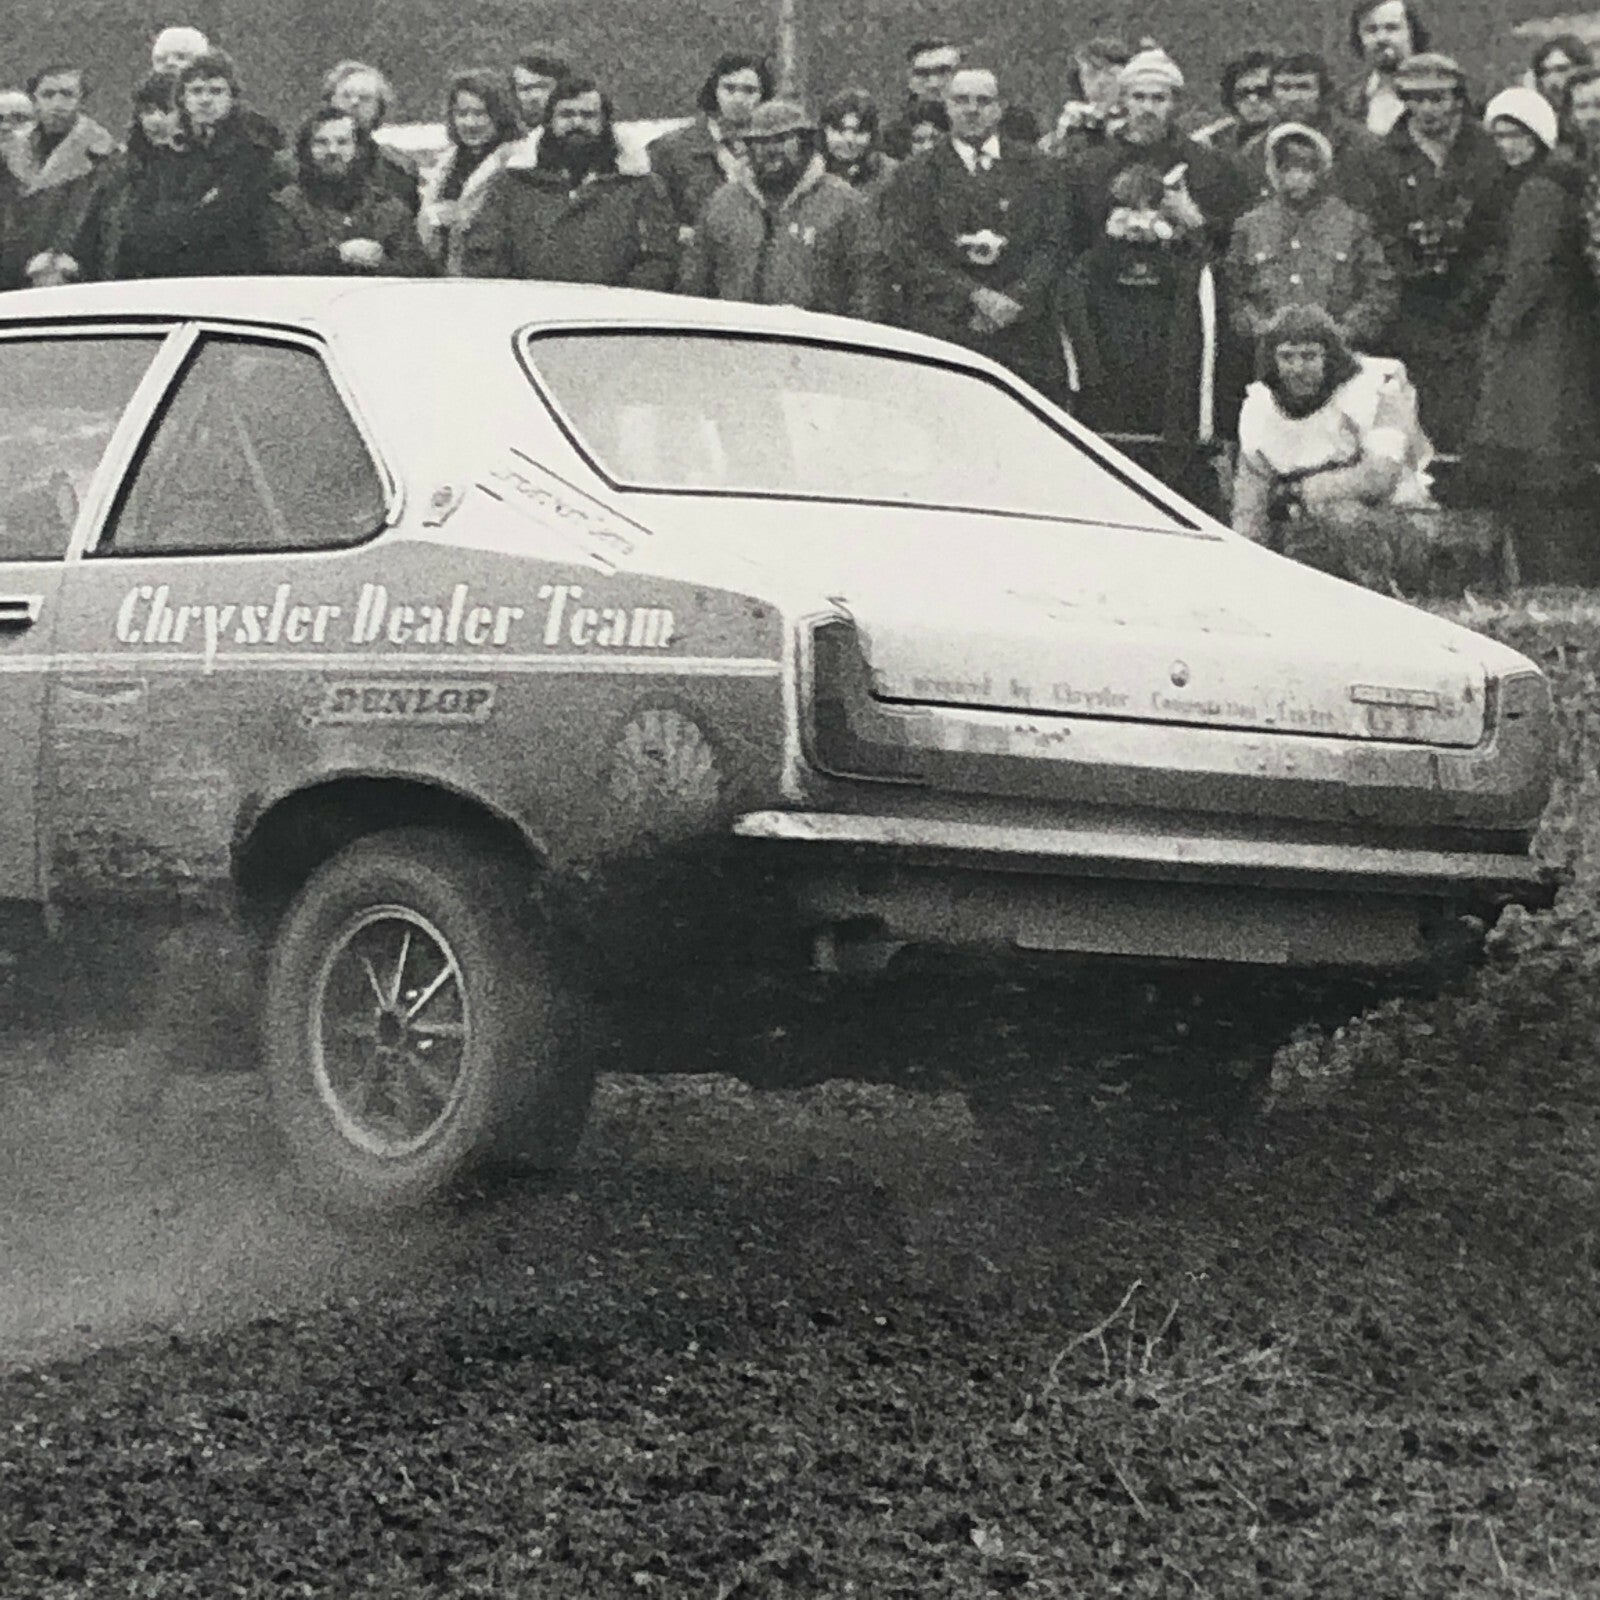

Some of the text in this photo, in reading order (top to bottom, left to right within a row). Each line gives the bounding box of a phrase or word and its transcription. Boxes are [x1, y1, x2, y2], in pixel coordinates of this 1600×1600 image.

[116, 582, 675, 675] Chrysler Dealer Team
